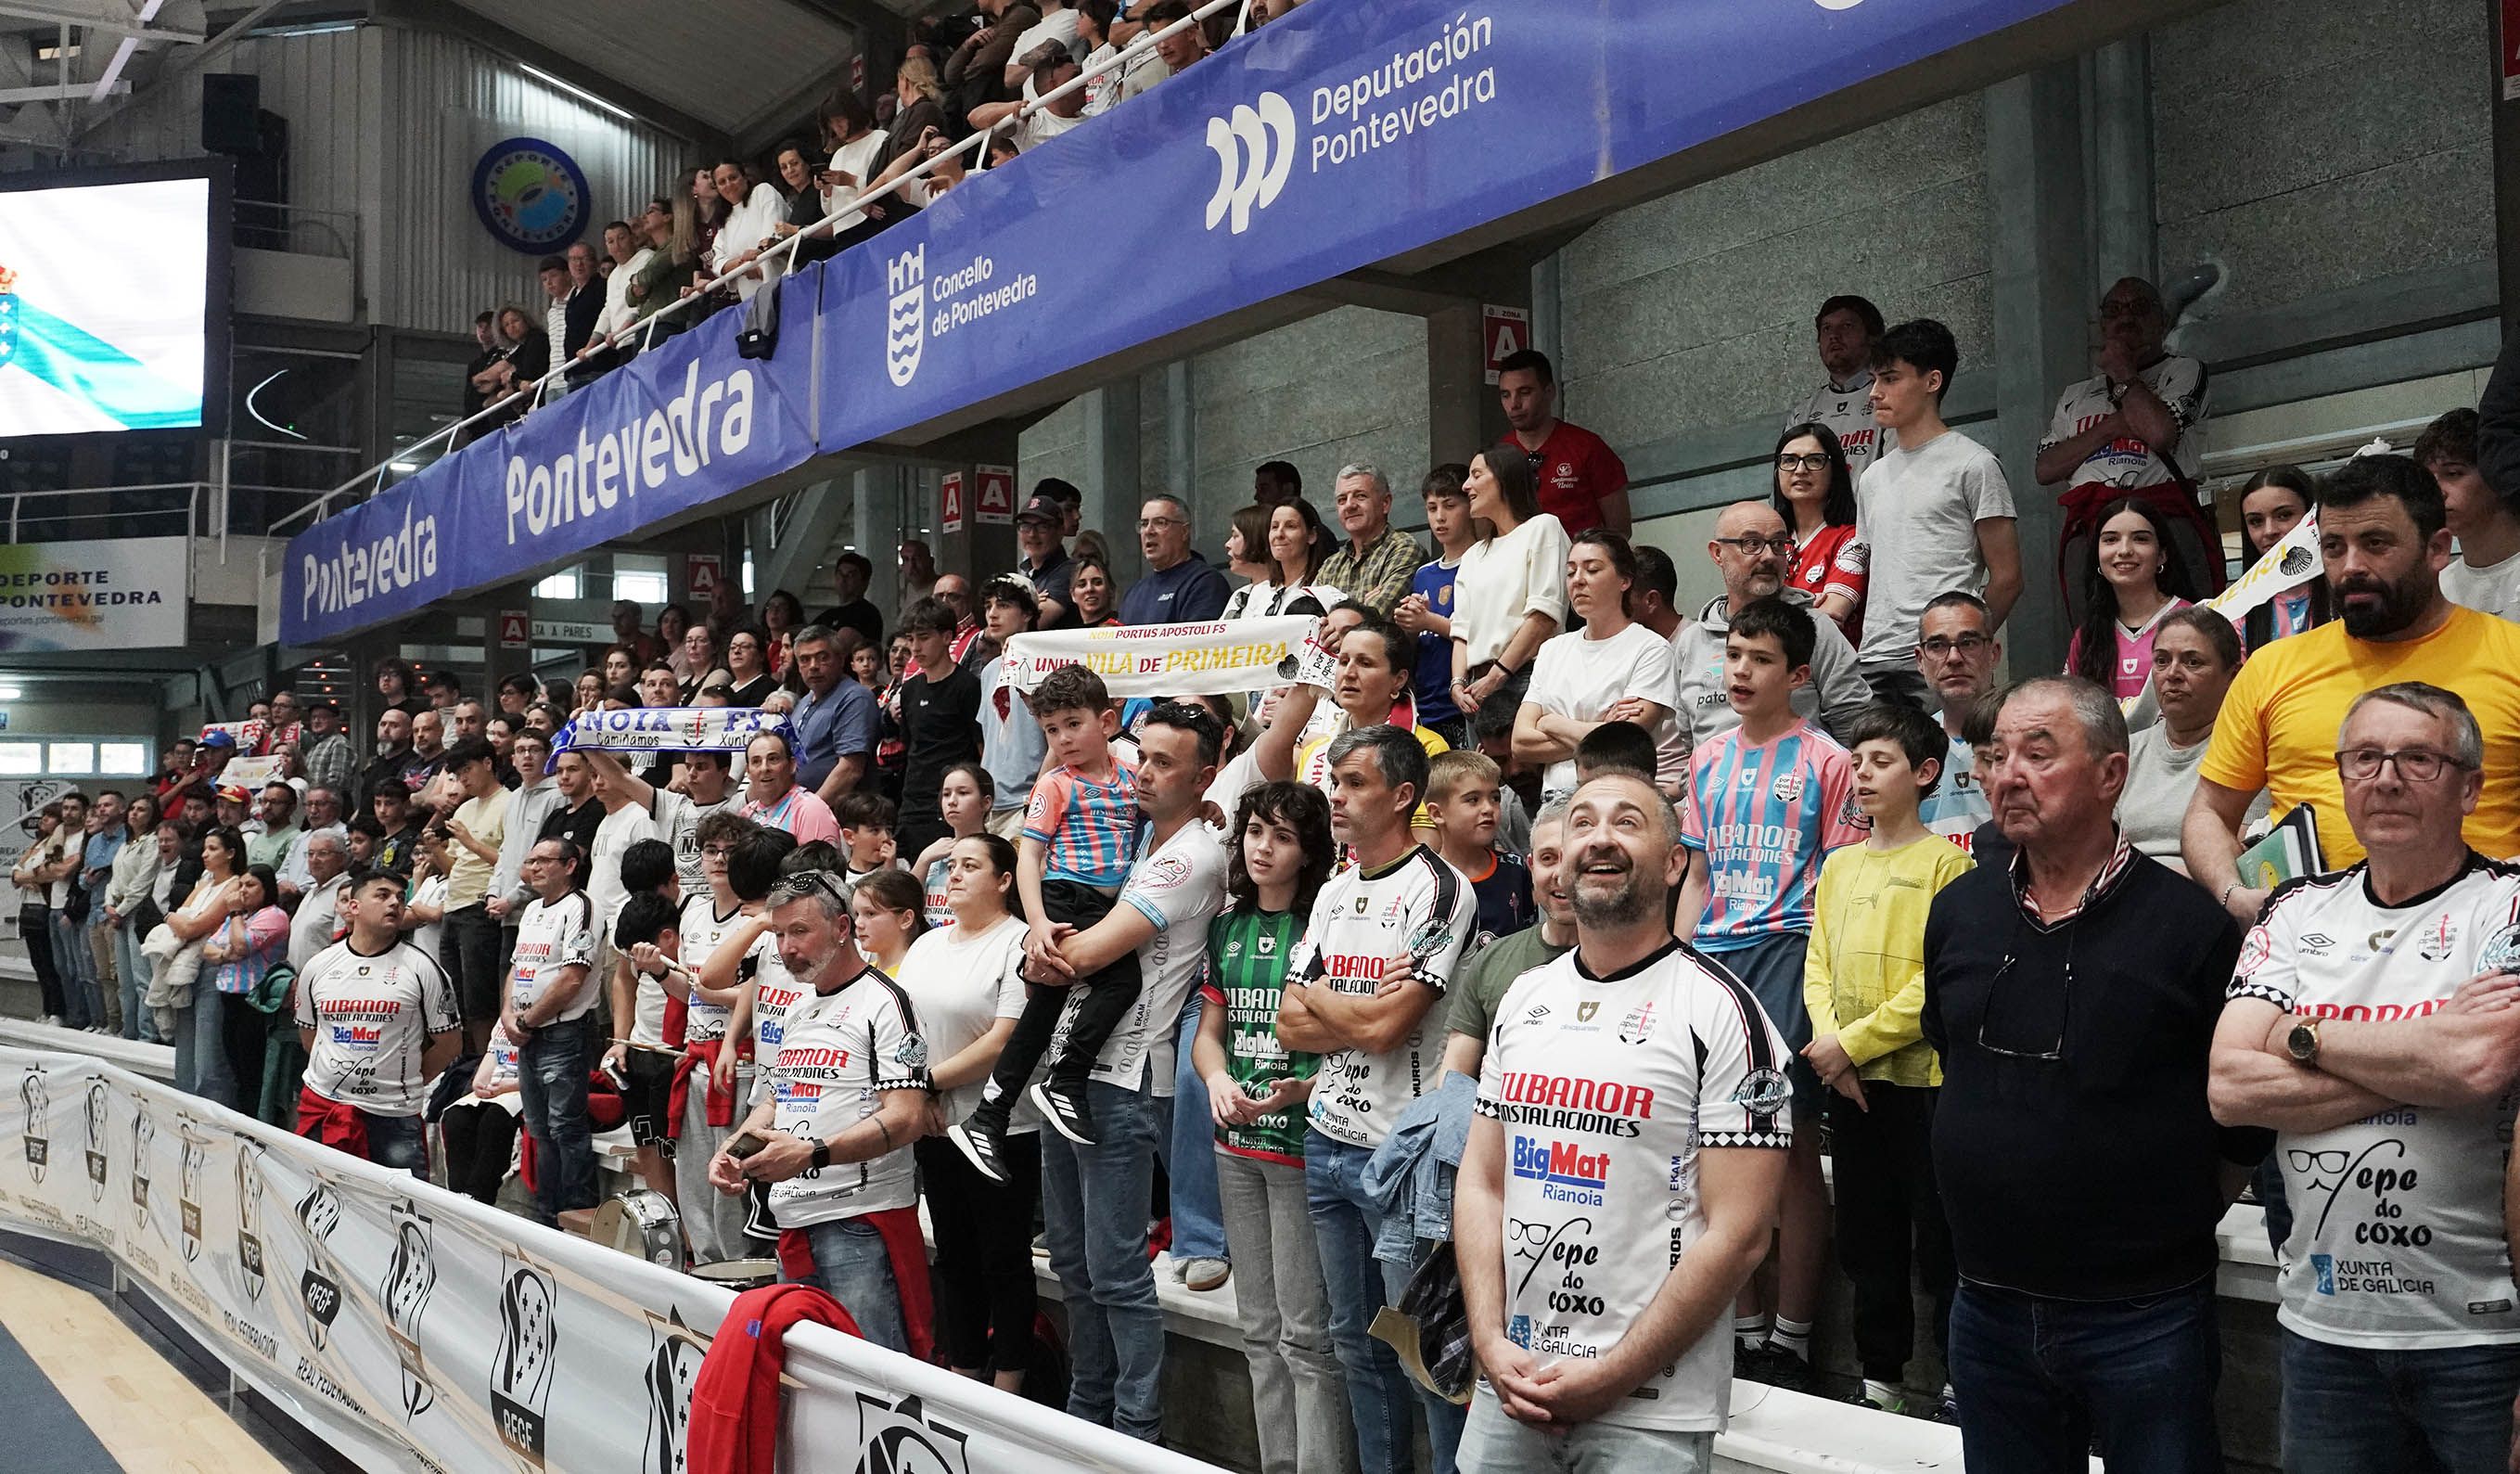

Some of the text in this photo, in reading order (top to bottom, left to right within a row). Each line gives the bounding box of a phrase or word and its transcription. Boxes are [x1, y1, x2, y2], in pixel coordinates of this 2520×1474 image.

[1311, 12, 1492, 125] Deputación
[1311, 67, 1496, 173] Pontevedra
[933, 255, 993, 302] Concello
[932, 274, 1037, 337] de Pontevedra
[1502, 310, 1521, 319] ZONA
[1491, 326, 1519, 362] A
[506, 358, 754, 545] Pontevedra
[945, 488, 959, 516] A
[981, 479, 1007, 507] A
[303, 502, 437, 622] Pontevedra
[694, 564, 714, 588] A
[505, 619, 523, 638] A
[551, 625, 557, 637] A
[563, 625, 592, 638] PARES
[1116, 628, 1158, 639] PORTUS
[1159, 625, 1210, 638] APOSTOLI
[1211, 623, 1227, 634] FS
[1084, 652, 1134, 675] VILA
[1138, 657, 1161, 673] DE
[1165, 641, 1288, 673] PRIMEIRA
[584, 711, 672, 732] NOIA
[723, 711, 765, 732] FS
[596, 732, 659, 746] Camiñamos
[2298, 947, 2329, 957] umbro
[1134, 1004, 1146, 1027] EKAM
[333, 1026, 381, 1042] BigMat
[1411, 1050, 1422, 1097] MUROS
[351, 1085, 377, 1095] coxo
[1500, 1070, 1655, 1120] TUBANOR
[1330, 1123, 1368, 1143] GALICIA
[1514, 1134, 1610, 1181] BigMat
[1669, 1155, 1682, 1192] EKAM
[781, 1186, 816, 1198] GALICIA
[1542, 1183, 1604, 1208] Rianoia
[2374, 1198, 2402, 1219] do
[2355, 1222, 2432, 1248] coxo
[1669, 1227, 1682, 1271] ROS
[2335, 1258, 2394, 1276] XUNTA
[1562, 1272, 1584, 1290] do
[2338, 1276, 2436, 1296] DE GALICIA
[307, 1281, 334, 1315] RFGF
[1548, 1290, 1605, 1317] coxo
[1541, 1336, 1597, 1359] GALICIA
